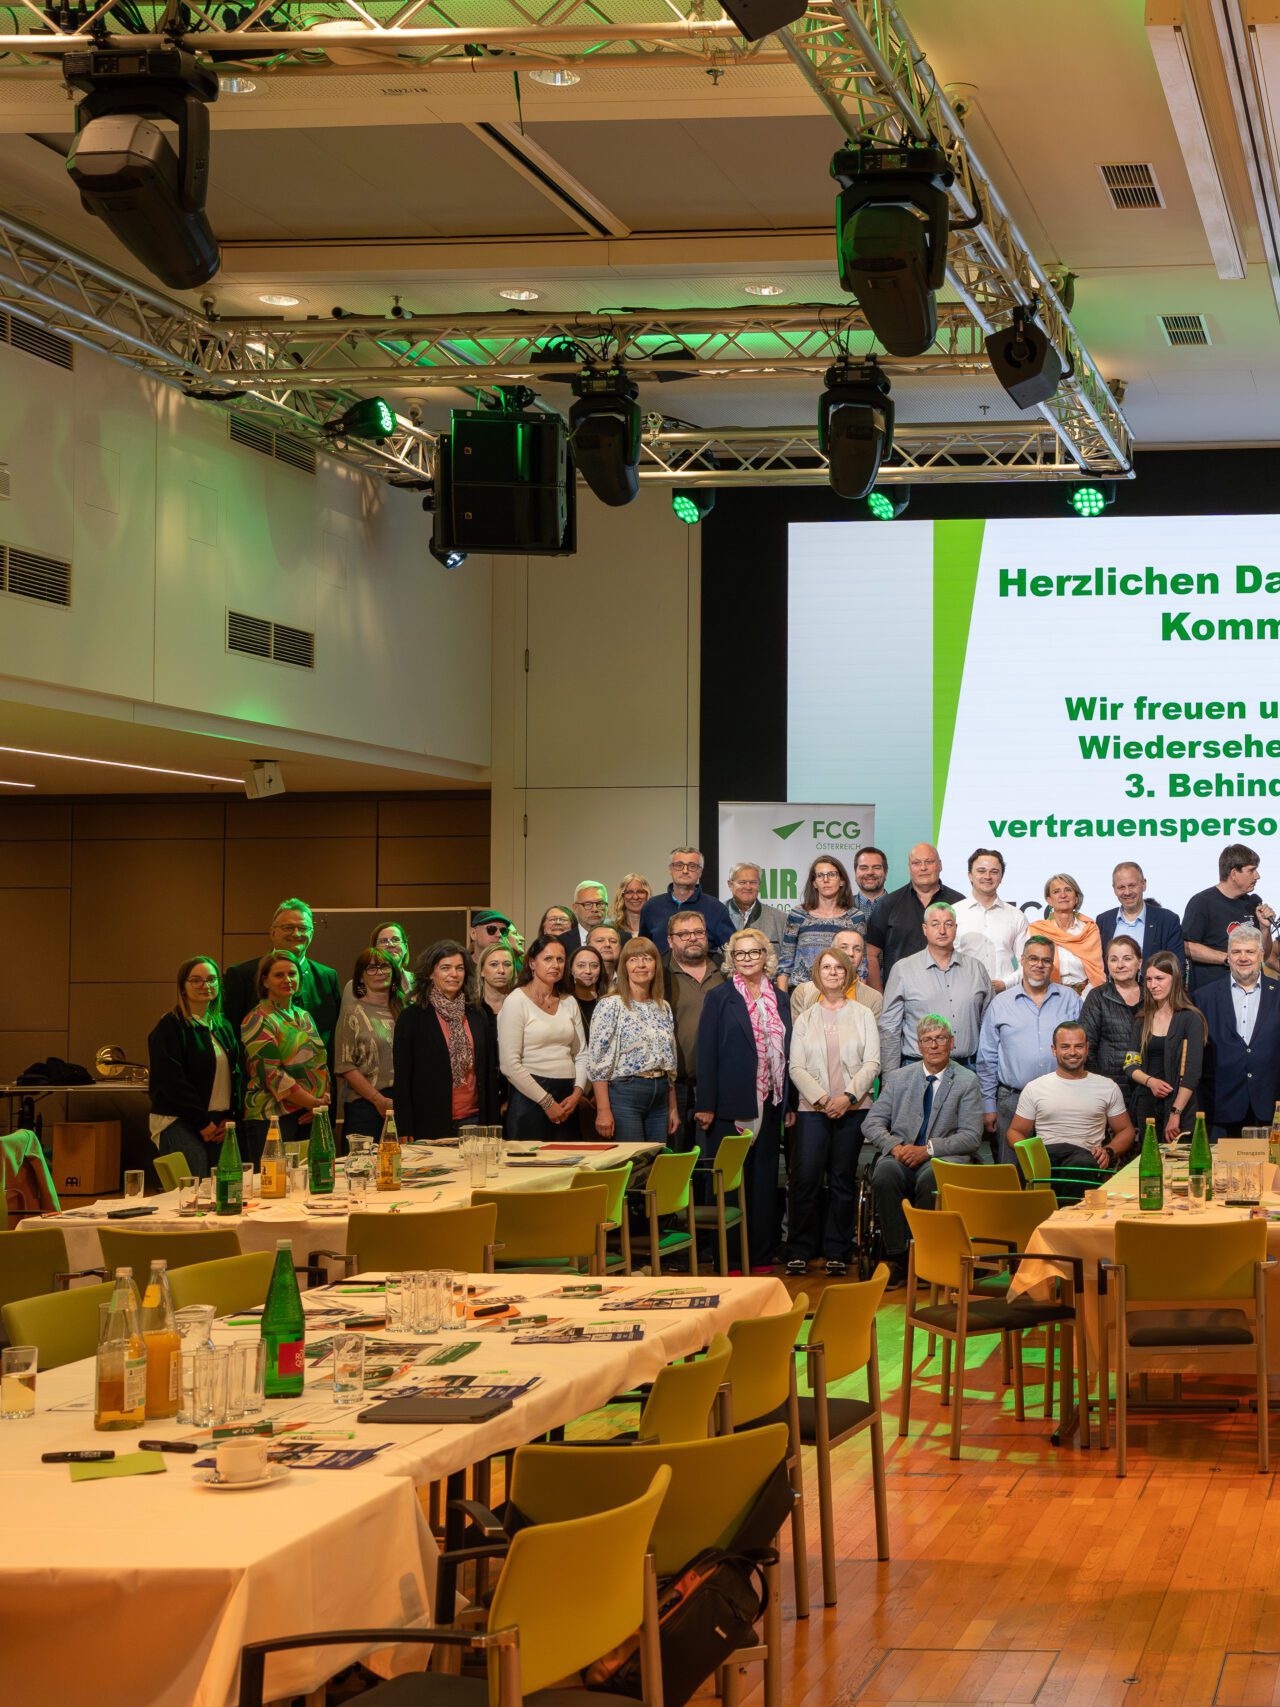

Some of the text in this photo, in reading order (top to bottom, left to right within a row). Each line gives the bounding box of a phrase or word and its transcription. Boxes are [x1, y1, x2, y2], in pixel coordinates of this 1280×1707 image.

[1000, 567, 1218, 598] Herzlichen
[1065, 697, 1124, 720] Wir
[1134, 696, 1246, 720] freuen
[1126, 774, 1155, 798] 3.
[813, 820, 861, 839] FCG
[816, 841, 861, 851] ÖSTERREICH
[758, 868, 798, 899] AIR
